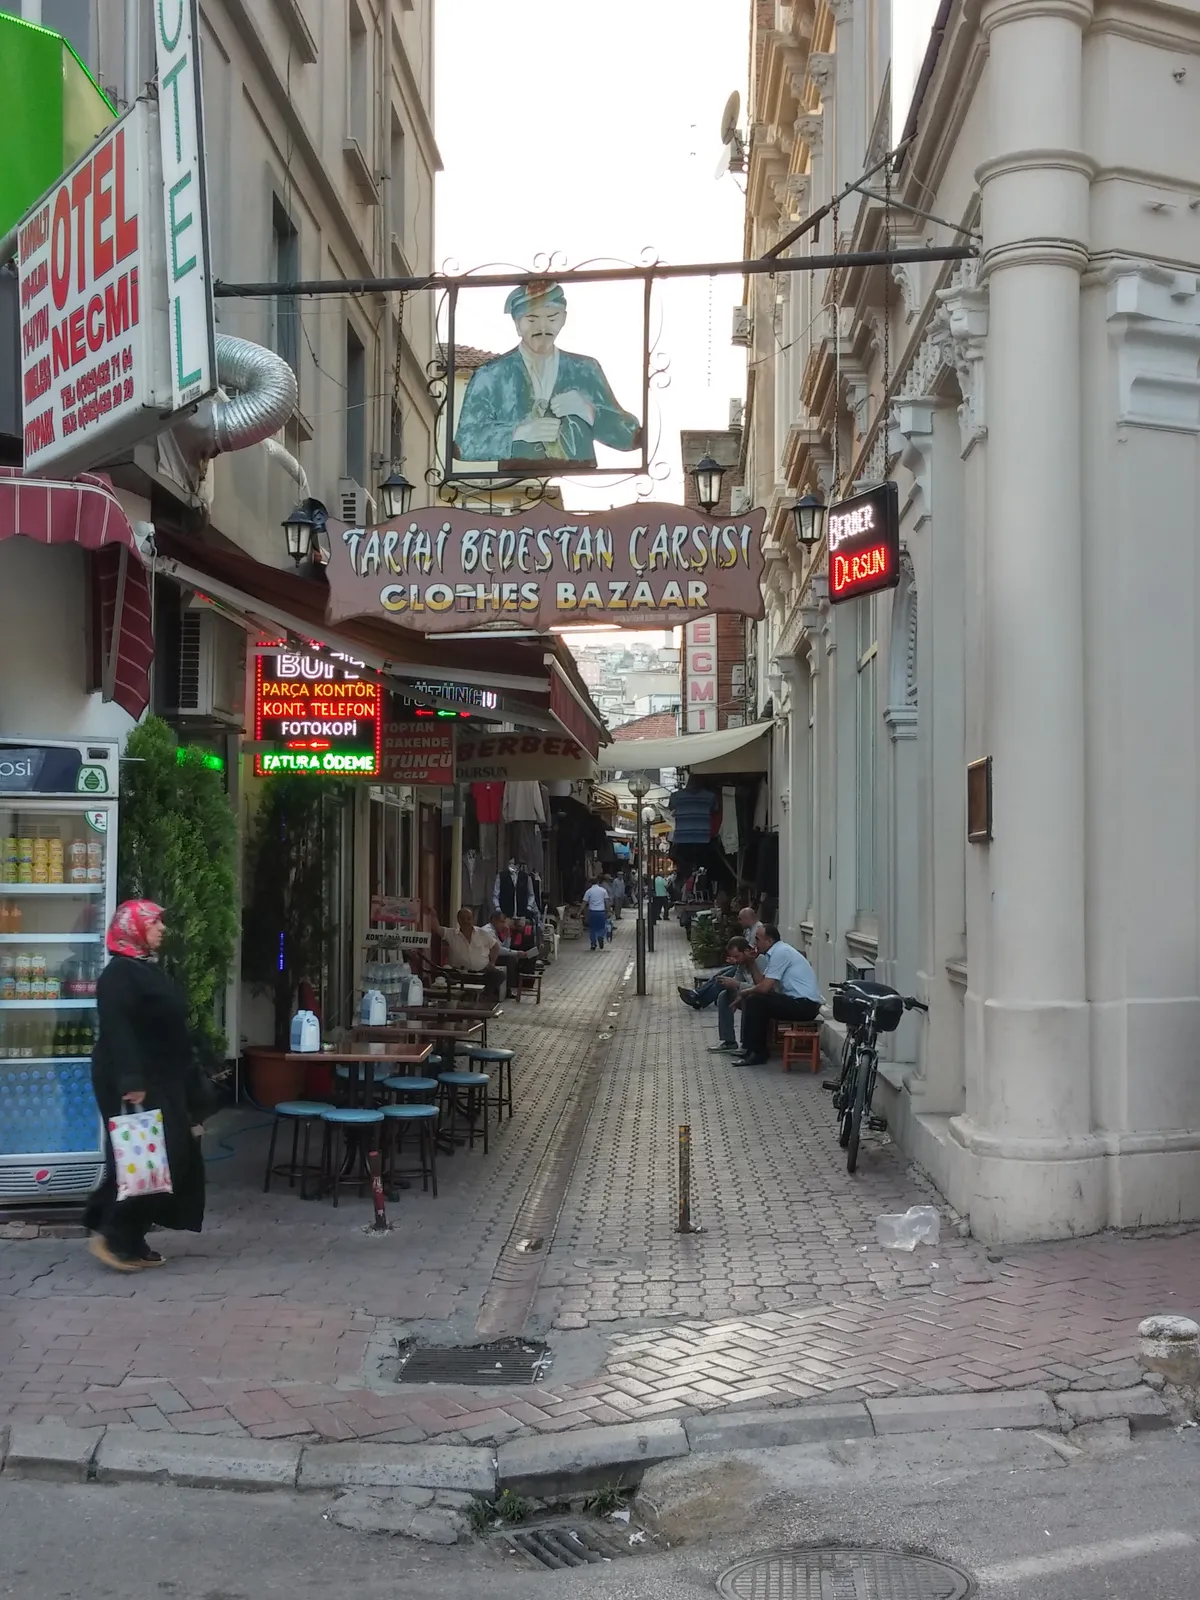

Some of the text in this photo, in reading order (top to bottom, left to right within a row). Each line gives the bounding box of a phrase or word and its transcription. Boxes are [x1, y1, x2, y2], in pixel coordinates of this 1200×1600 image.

[51, 128, 138, 311] OTEL
[829, 504, 875, 551] BERBER
[342, 522, 752, 578] TARİHİ BEDESTAN ÇARŞISI
[555, 580, 710, 611] BAZAAR
[262, 681, 376, 698] PARÇA KONTÖR
[263, 702, 375, 716] KONT. TELEFON
[281, 720, 357, 736] FOTOKOPİ
[262, 752, 375, 771] FATURA ÖDEME
[456, 735, 583, 762] BERBER
